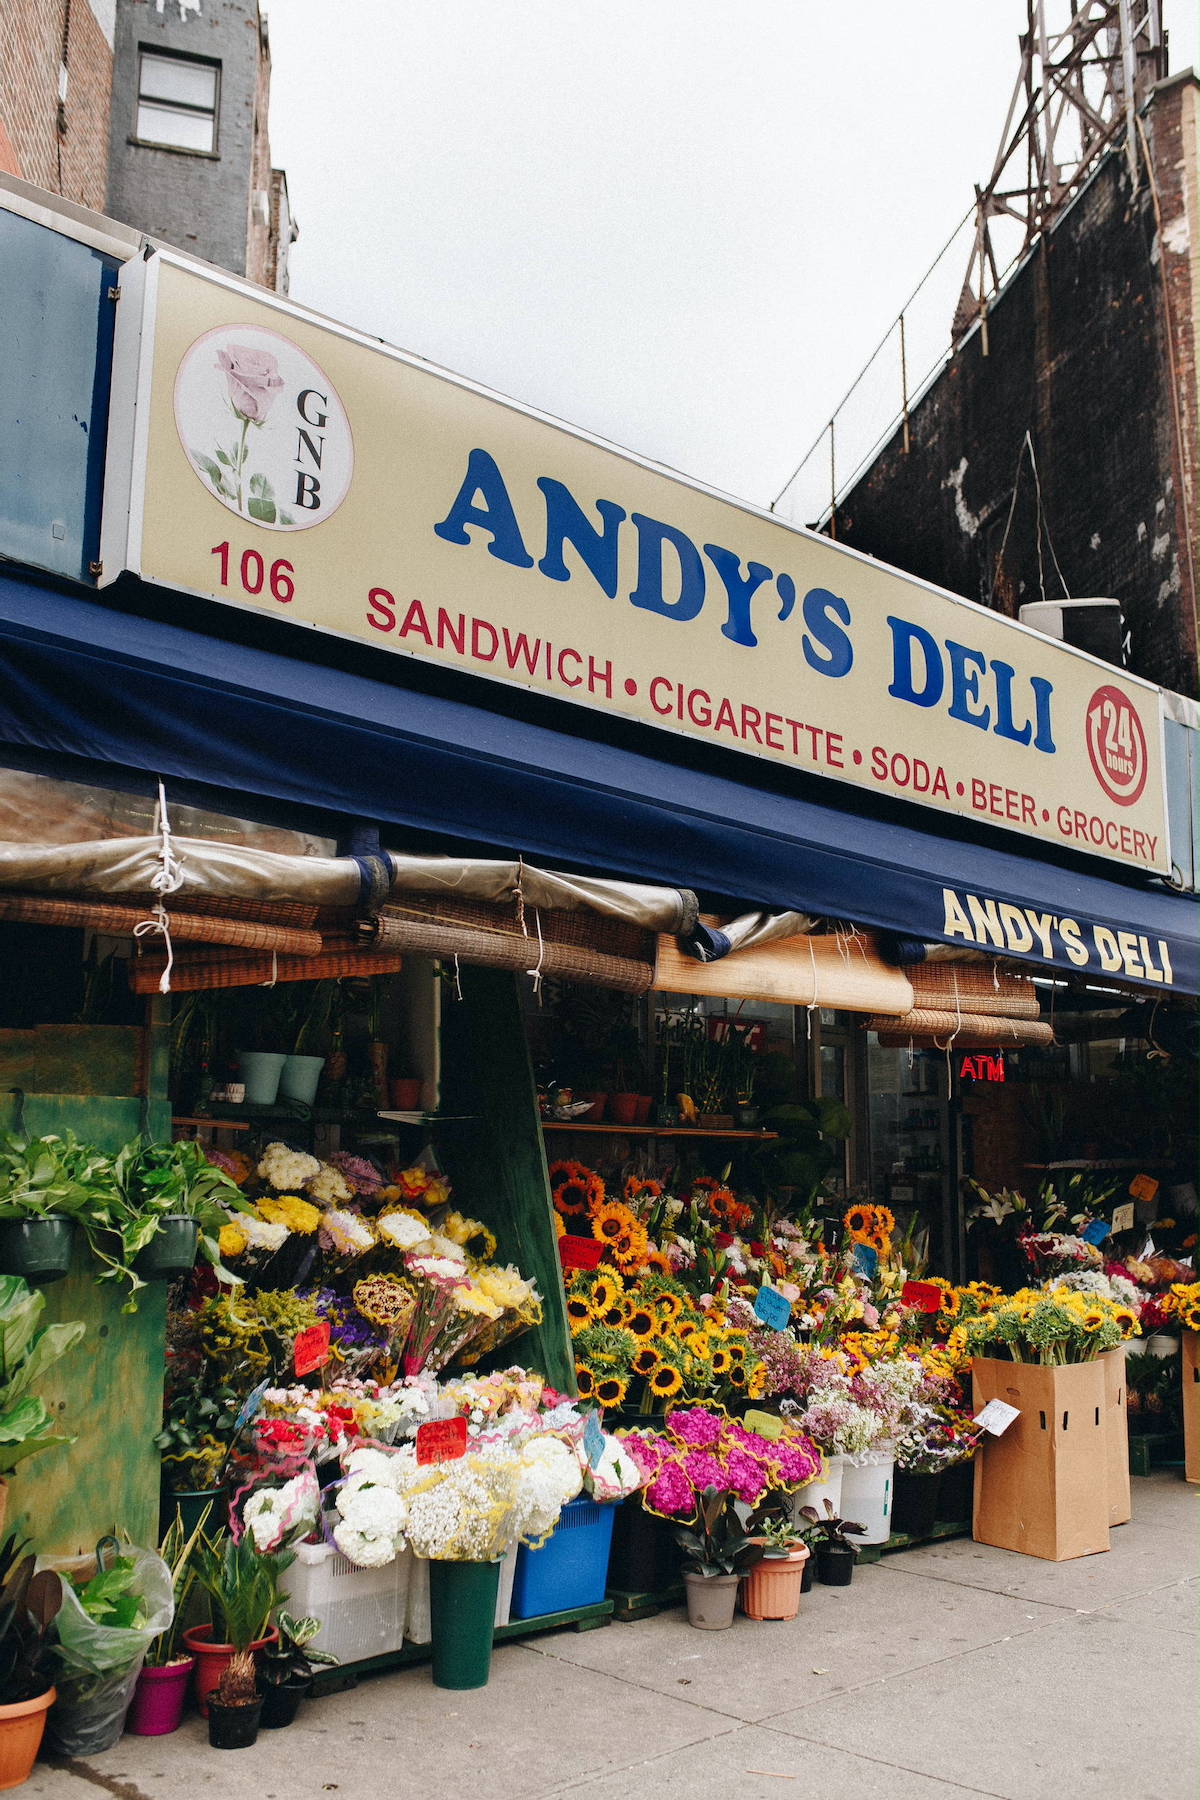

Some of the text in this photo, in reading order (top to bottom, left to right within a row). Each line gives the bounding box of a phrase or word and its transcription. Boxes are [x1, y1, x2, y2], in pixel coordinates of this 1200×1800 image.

[294, 388, 329, 511] GNB
[210, 541, 296, 604] 106
[434, 448, 1057, 755] ANDY'S DELI
[367, 587, 1159, 863] SANDWICH CIGARETTE SODA BEER GROCERY
[1103, 699, 1133, 757] 24
[1105, 749, 1134, 777] hours
[942, 888, 1173, 985] ANDY'S DELI
[959, 1054, 1006, 1082] ATM
